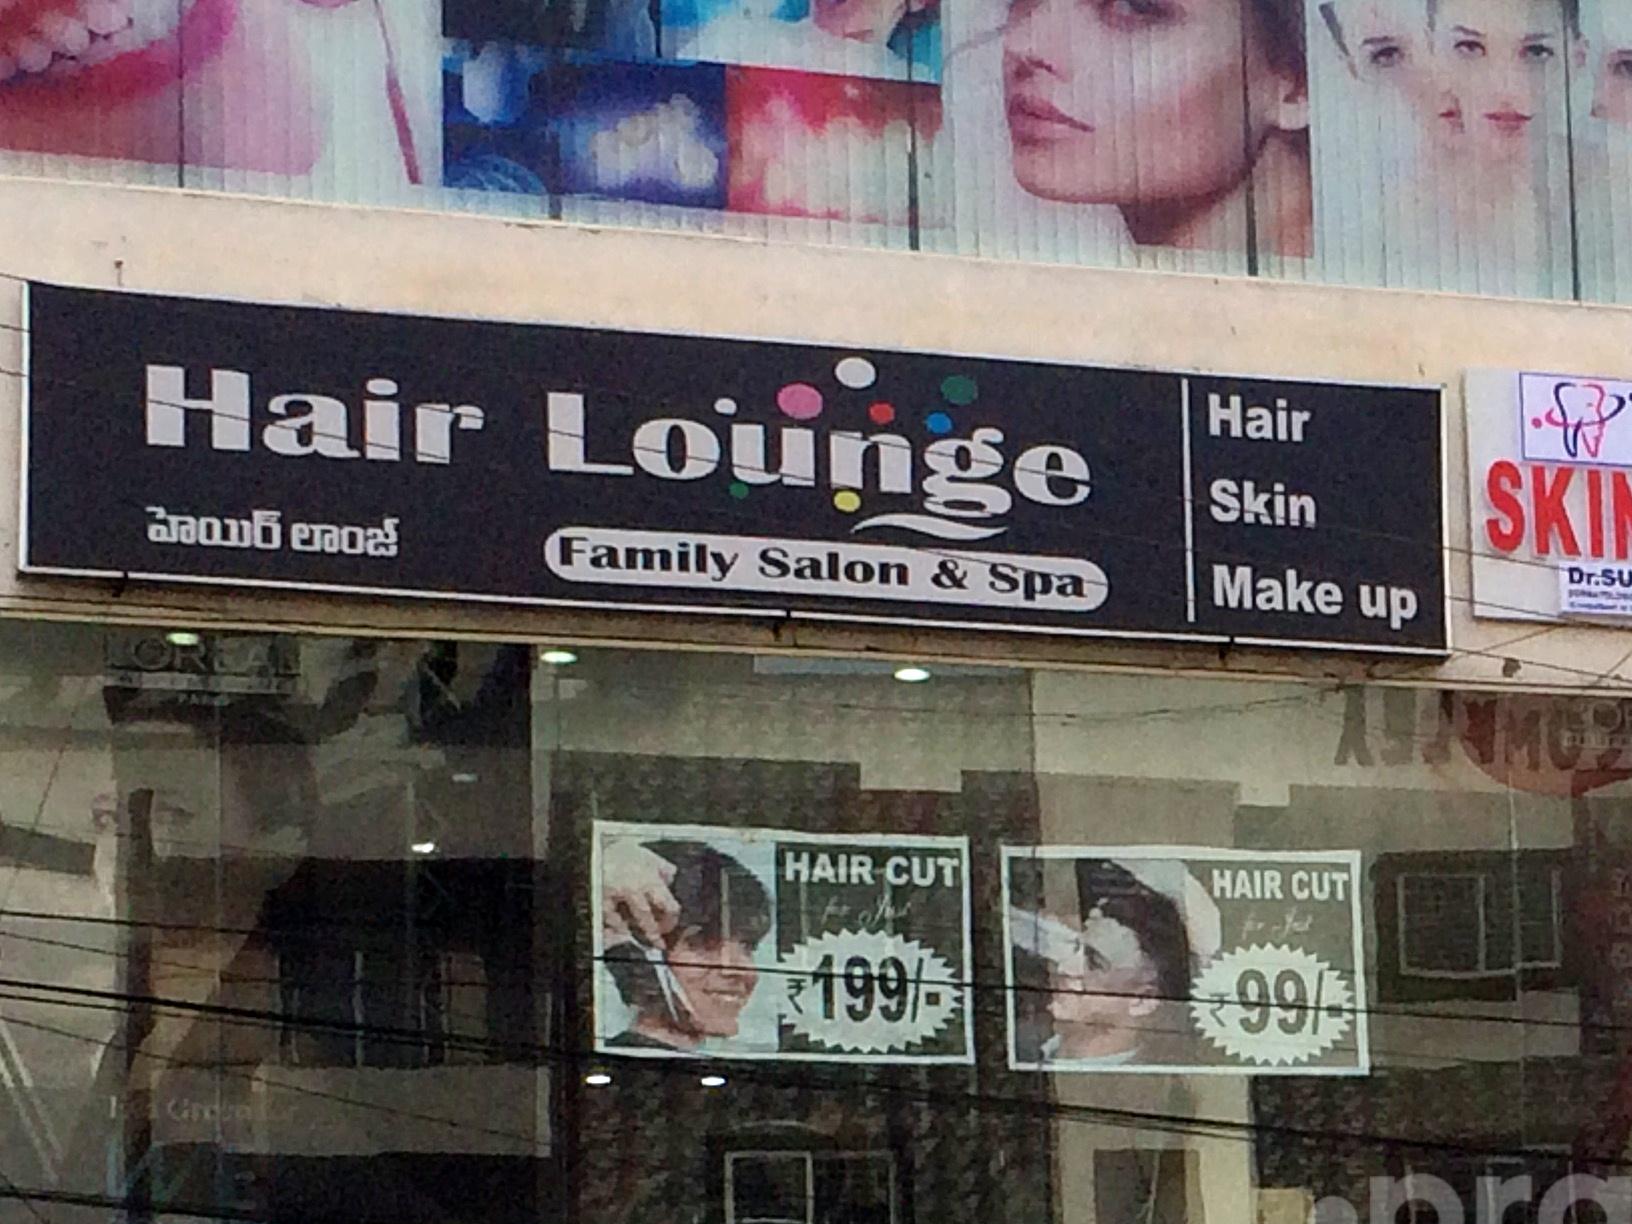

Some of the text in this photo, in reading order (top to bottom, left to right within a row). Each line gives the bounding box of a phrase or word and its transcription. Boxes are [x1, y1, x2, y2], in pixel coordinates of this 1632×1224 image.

[145, 364, 1092, 519] Hair Lounge
[1209, 394, 1311, 443] Hair
[1210, 479, 1317, 528] Skin
[558, 535, 1087, 607] Family Salon & Spa
[1212, 564, 1419, 631] Make up
[785, 851, 961, 888] HAIR CUT
[1212, 868, 1350, 901] HAIR CUT
